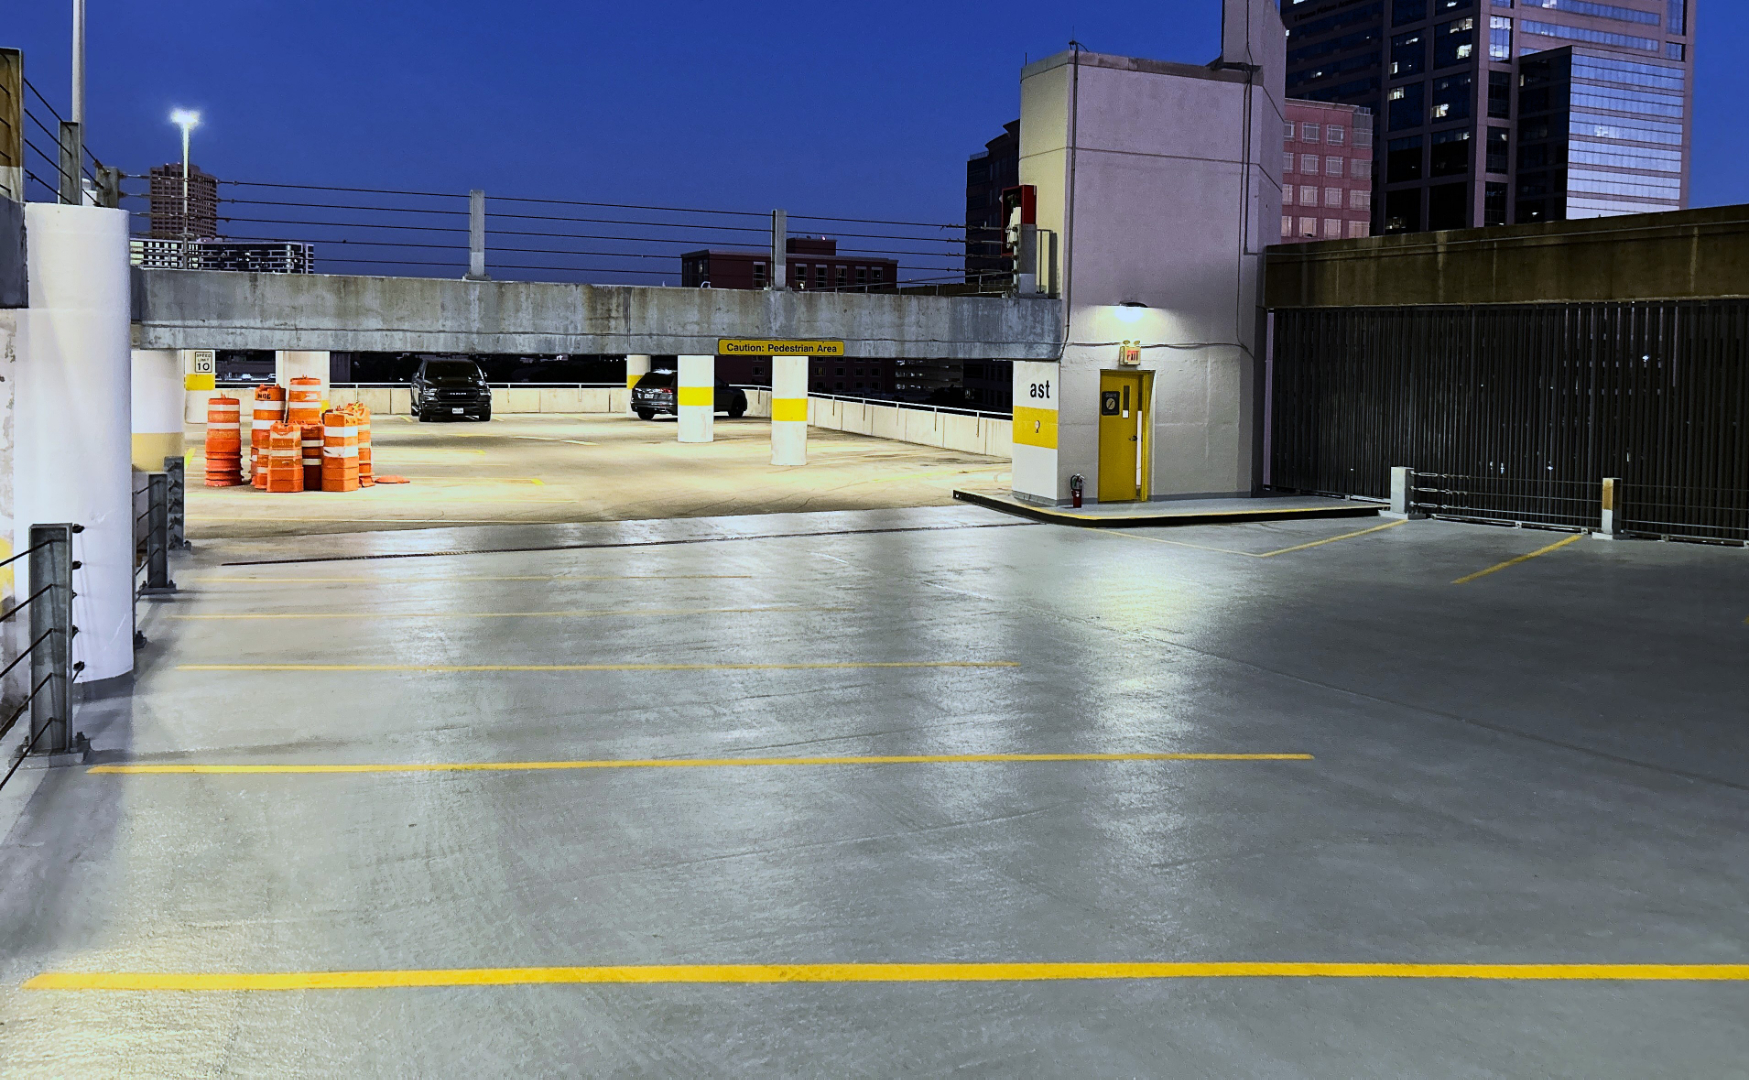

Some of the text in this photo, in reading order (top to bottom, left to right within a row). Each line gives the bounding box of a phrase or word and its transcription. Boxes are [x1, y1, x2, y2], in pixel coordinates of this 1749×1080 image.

[726, 343, 837, 353] Caution: Pedestrian Area
[197, 363, 210, 371] 10
[1030, 380, 1050, 399] ast
